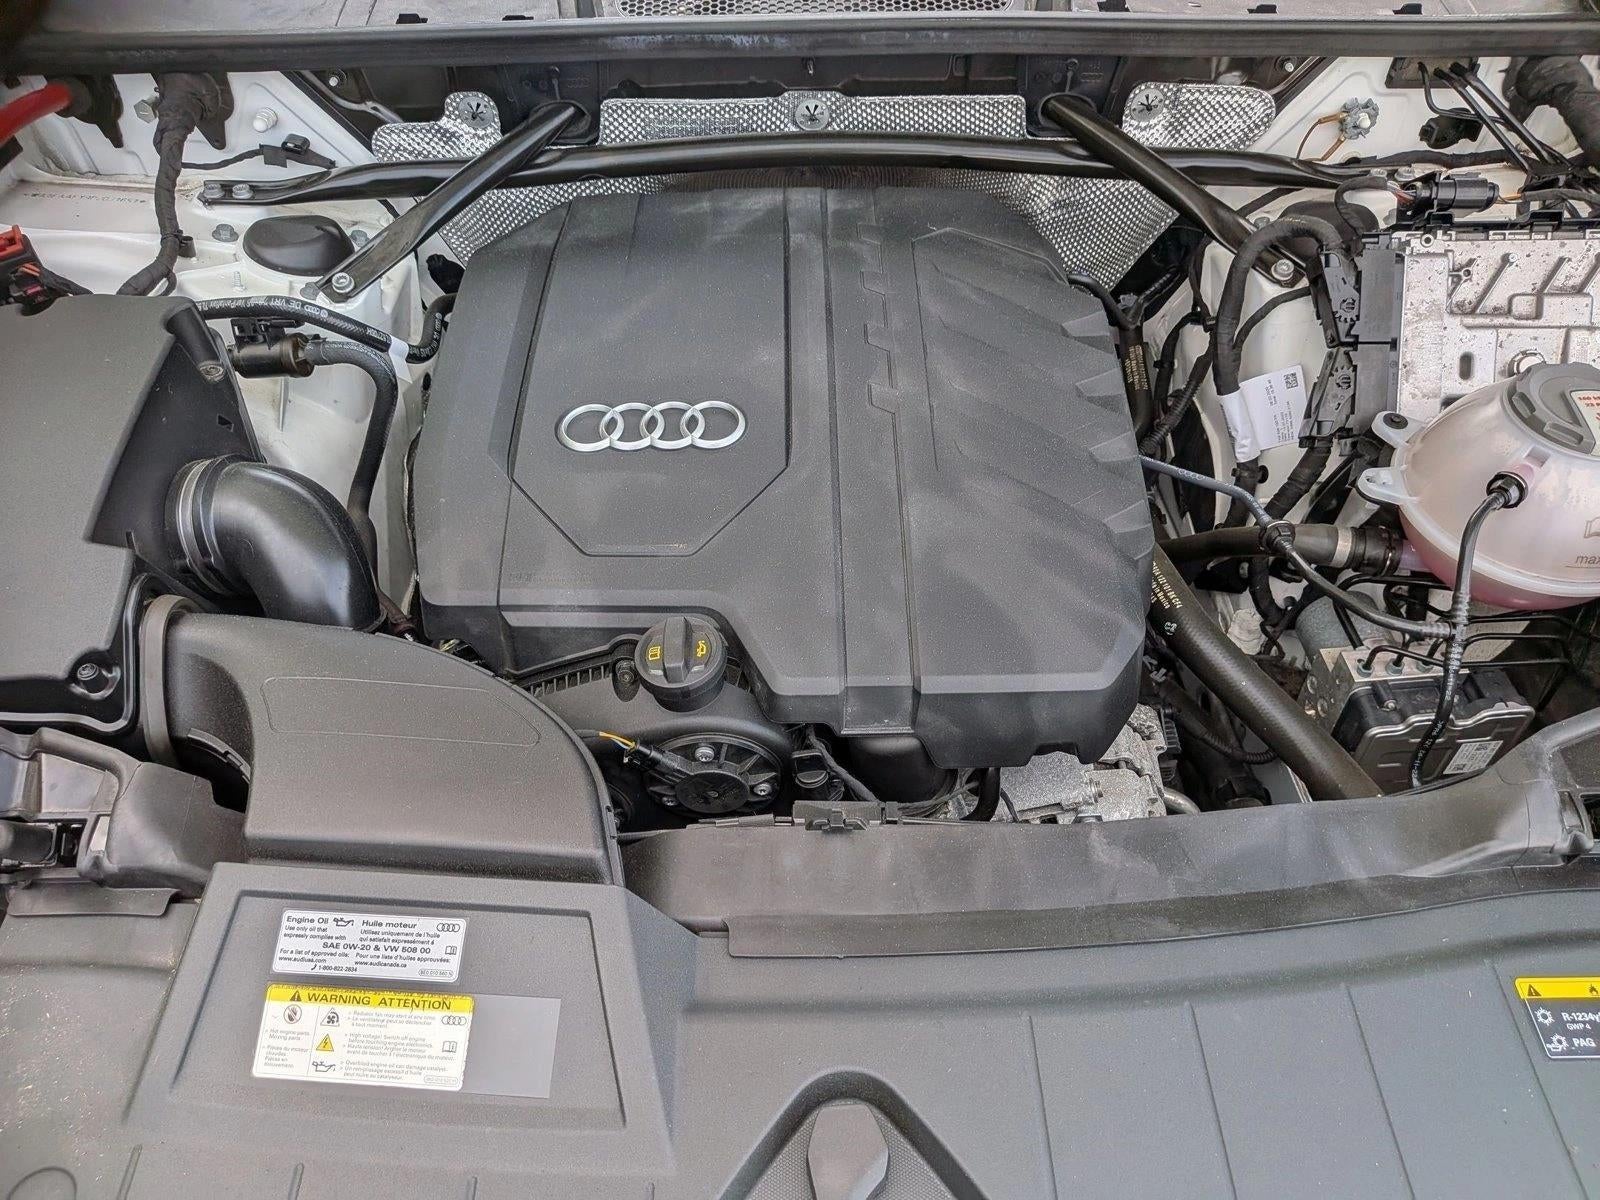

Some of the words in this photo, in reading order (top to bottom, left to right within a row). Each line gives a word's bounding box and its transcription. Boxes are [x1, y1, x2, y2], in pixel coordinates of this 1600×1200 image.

[286, 915, 315, 925] Engine
[317, 917, 329, 925] Oil
[361, 920, 384, 928] Huile
[385, 921, 417, 929] moteur
[322, 941, 341, 950] SAE
[342, 942, 371, 951] 0W-20
[383, 944, 399, 952] VW
[401, 946, 418, 954] 508
[354, 960, 407, 968] www.audicanada.ca
[307, 992, 371, 1006] WARNING
[378, 997, 452, 1010] ATTENTION
[1572, 1038, 1597, 1047] PAG
